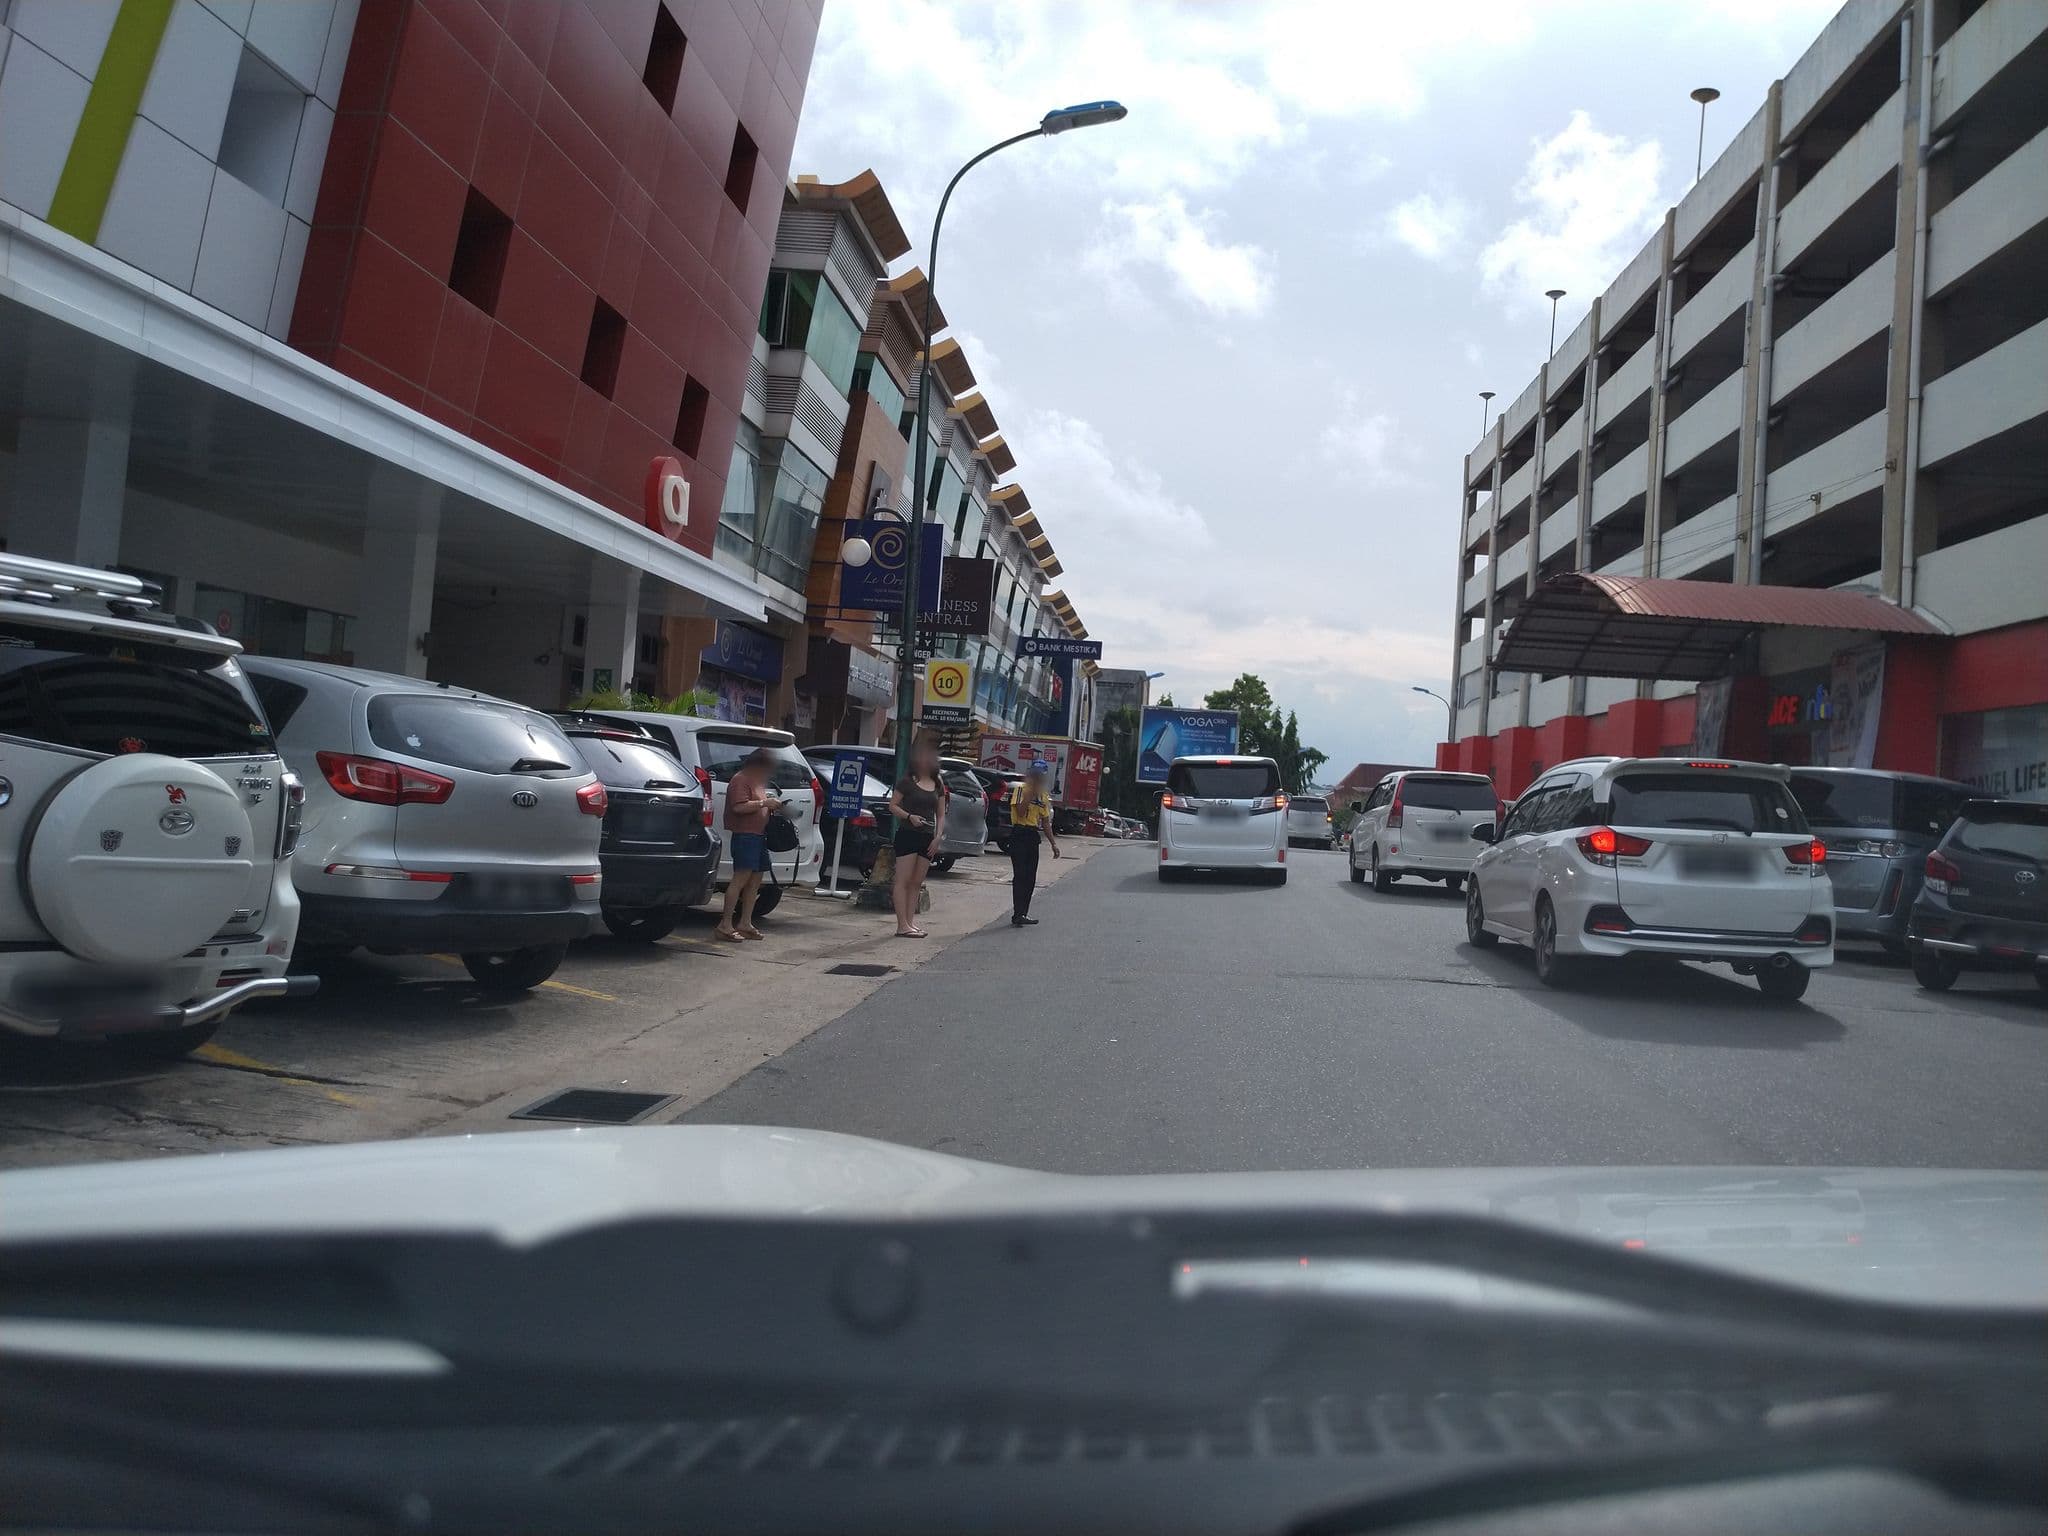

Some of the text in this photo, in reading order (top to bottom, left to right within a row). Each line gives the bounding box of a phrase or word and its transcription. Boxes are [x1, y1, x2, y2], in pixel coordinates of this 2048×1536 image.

[940, 599, 978, 612] NESS
[1039, 643, 1097, 654] BANK MESTIKA
[937, 677, 953, 689] 10
[1768, 695, 1799, 726] ACE
[1180, 716, 1214, 727] YOGA
[992, 742, 1010, 752] ACE
[1076, 752, 1098, 772] ACE
[2015, 761, 2047, 793] LIFE
[516, 794, 535, 806] KIA
